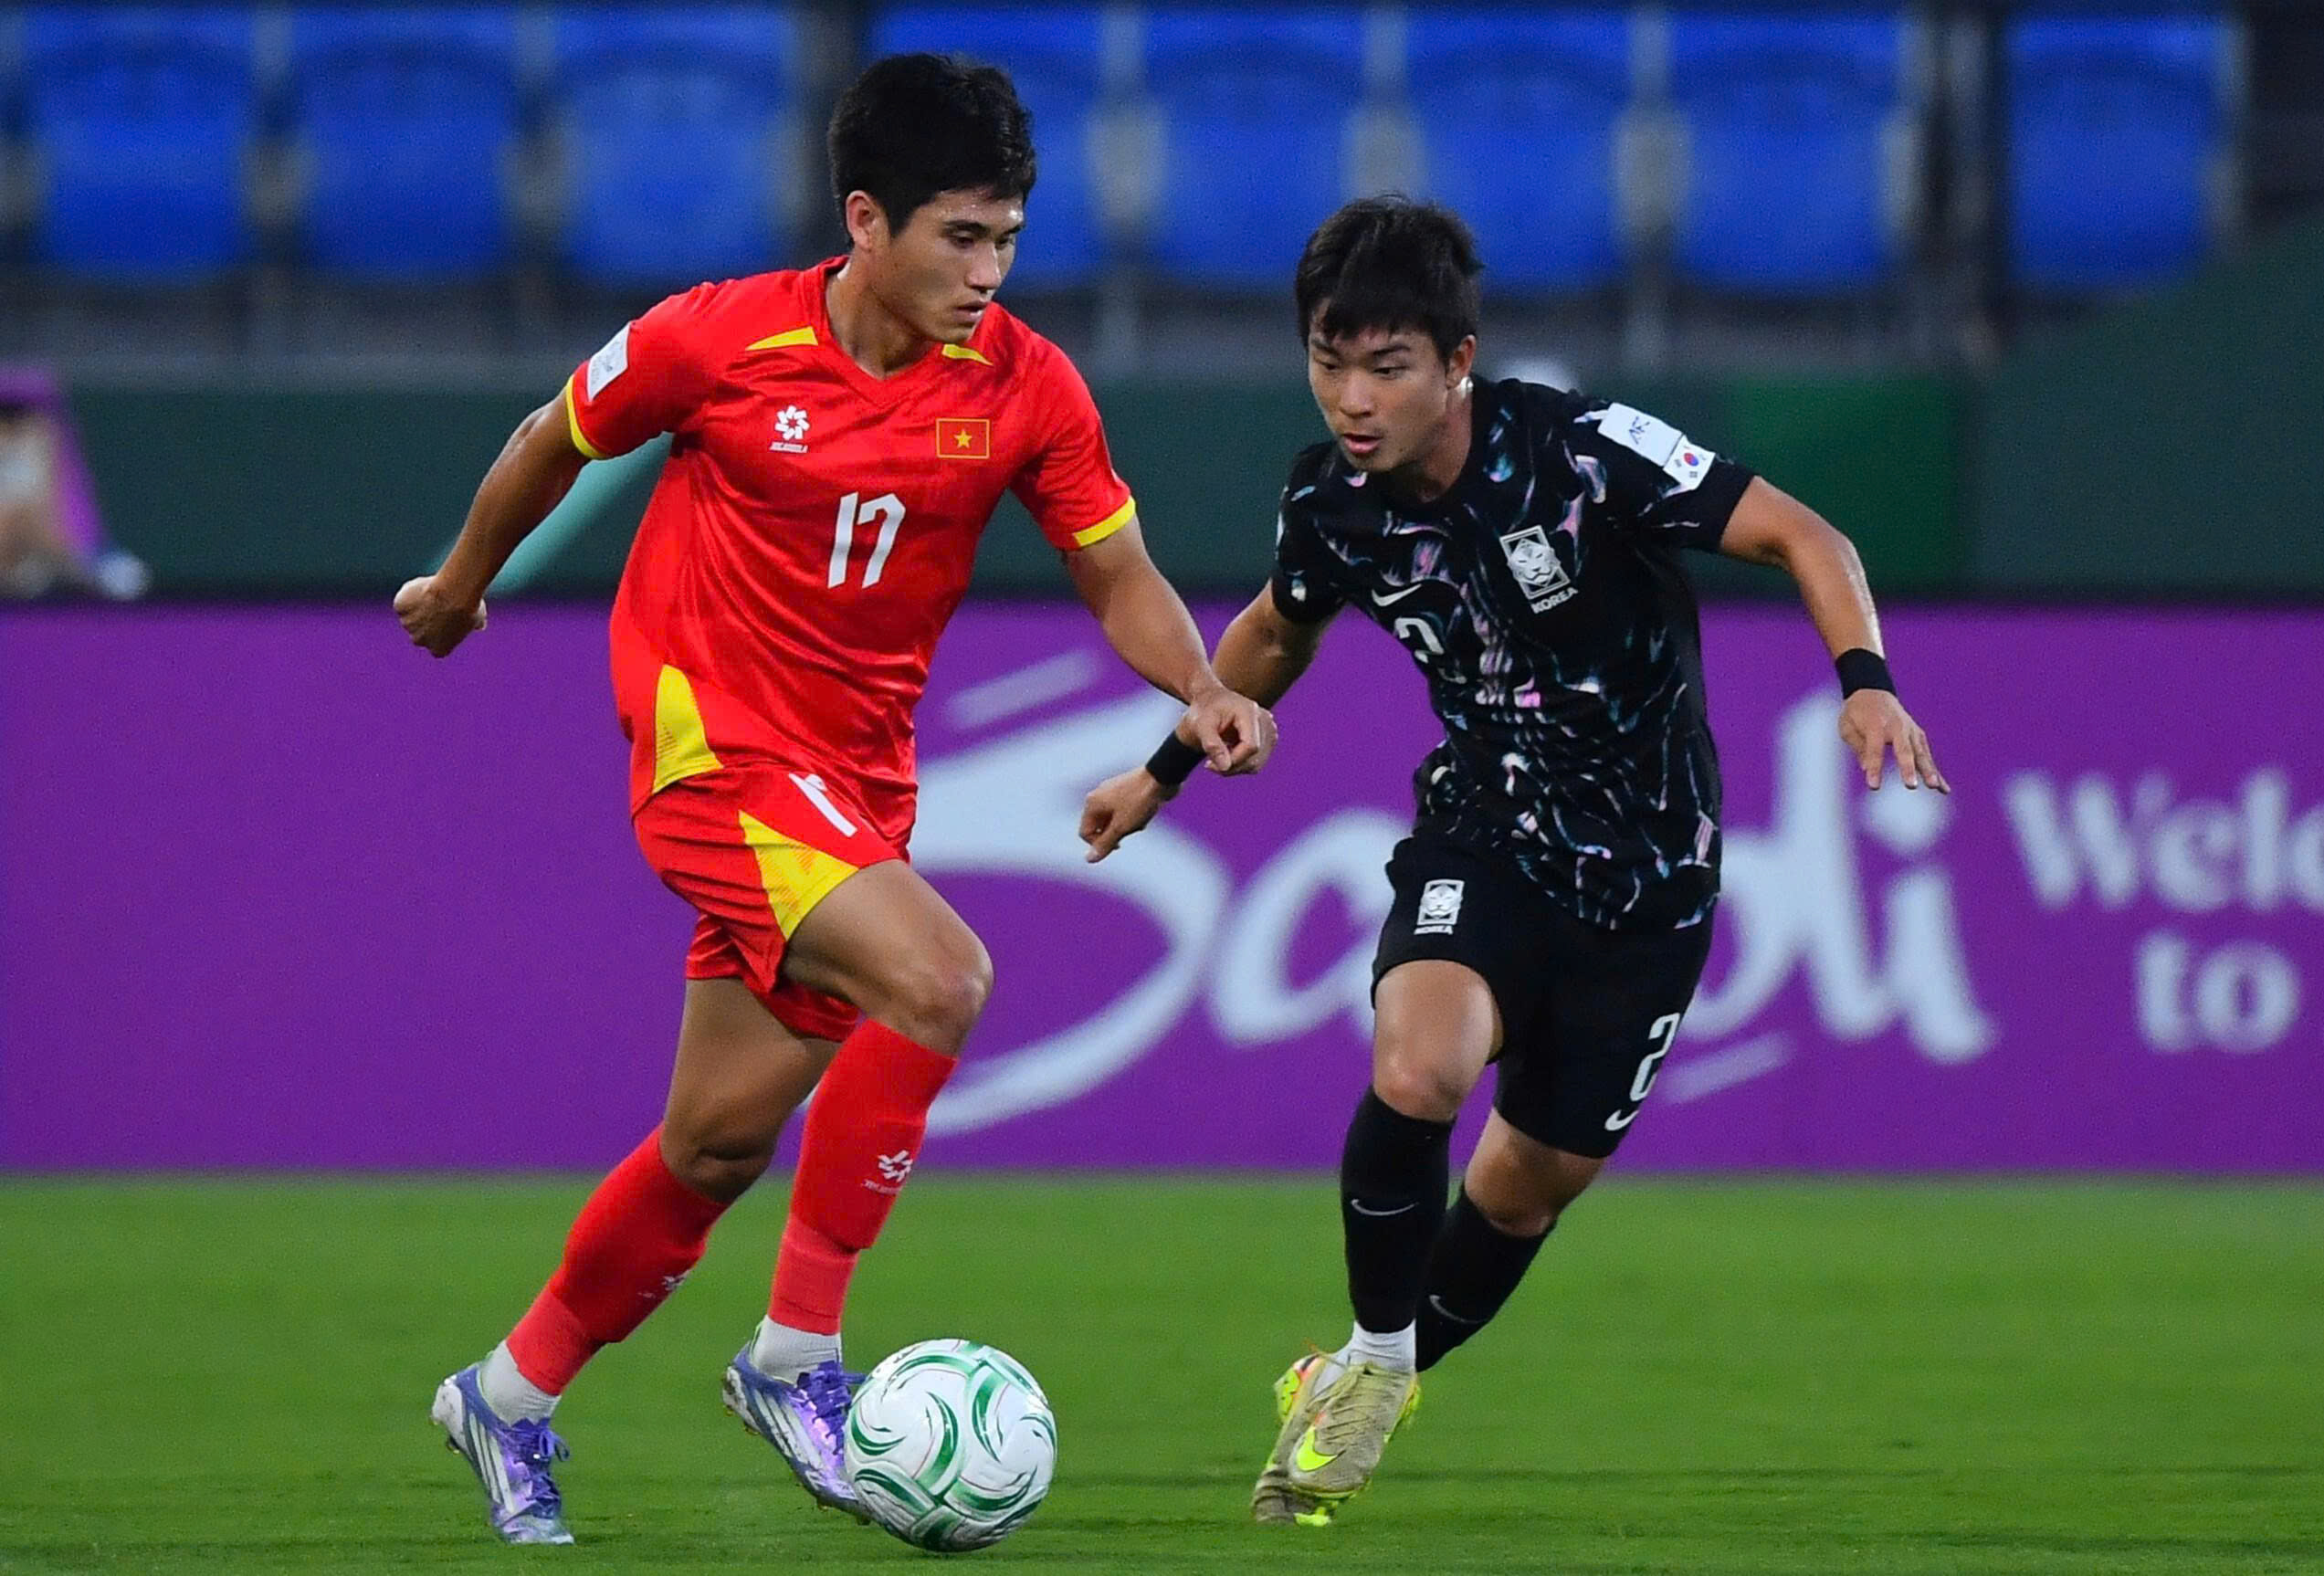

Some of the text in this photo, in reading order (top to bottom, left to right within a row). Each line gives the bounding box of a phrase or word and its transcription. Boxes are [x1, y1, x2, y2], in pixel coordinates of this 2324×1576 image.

[827, 491, 906, 589] 17
[1530, 587, 1579, 614] KOREA
[796, 683, 1993, 1135] Sadi
[2137, 931, 2297, 1050] to
[1629, 1013, 1680, 1101] 2
